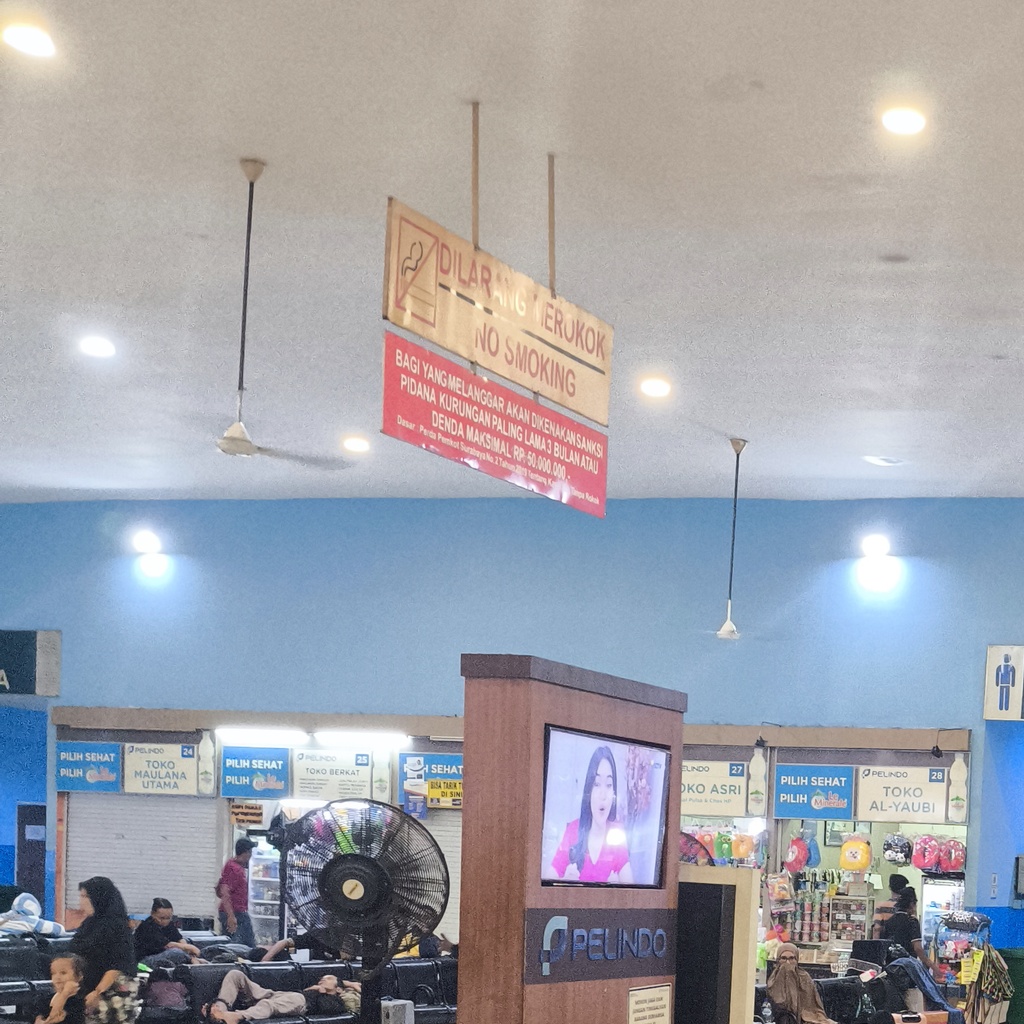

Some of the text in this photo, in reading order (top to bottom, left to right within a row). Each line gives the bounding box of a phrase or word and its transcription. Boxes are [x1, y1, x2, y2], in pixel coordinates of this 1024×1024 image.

[475, 322, 576, 397] NO SMOKING
[395, 349, 603, 459] BAGI YANG MELANGGAR AKAN DIKENAKAN SANKSI
[401, 373, 599, 475] PIDANA KURUNGAN PALING LAMA 3 BULAN ATAU
[432, 410, 465, 439] DENDA
[466, 424, 512, 459] MAKSIMAL
[182, 747, 194, 756] 24
[60, 752, 116, 763] PILIH SEHAT
[356, 754, 368, 764] 25
[145, 759, 175, 770] TOKO
[225, 758, 284, 770] PILIH SEHAT
[431, 764, 463, 774] SEHAT
[60, 768, 83, 778] PILIH
[134, 770, 187, 781] MAULANA
[305, 767, 360, 777] TOKO BERKAT
[731, 766, 743, 774] 27
[872, 770, 908, 778] PELINDO
[931, 771, 943, 780] 28
[142, 780, 179, 790] UTAMA
[225, 775, 250, 786] PILIH
[780, 776, 847, 787] PILIH SEHAT
[441, 790, 447, 798] DI
[710, 784, 741, 795] ASRI
[882, 786, 923, 798] TOKO
[780, 793, 808, 804] PILIH
[868, 800, 935, 813] AL-YAUBI
[571, 928, 667, 960] PELINDO
